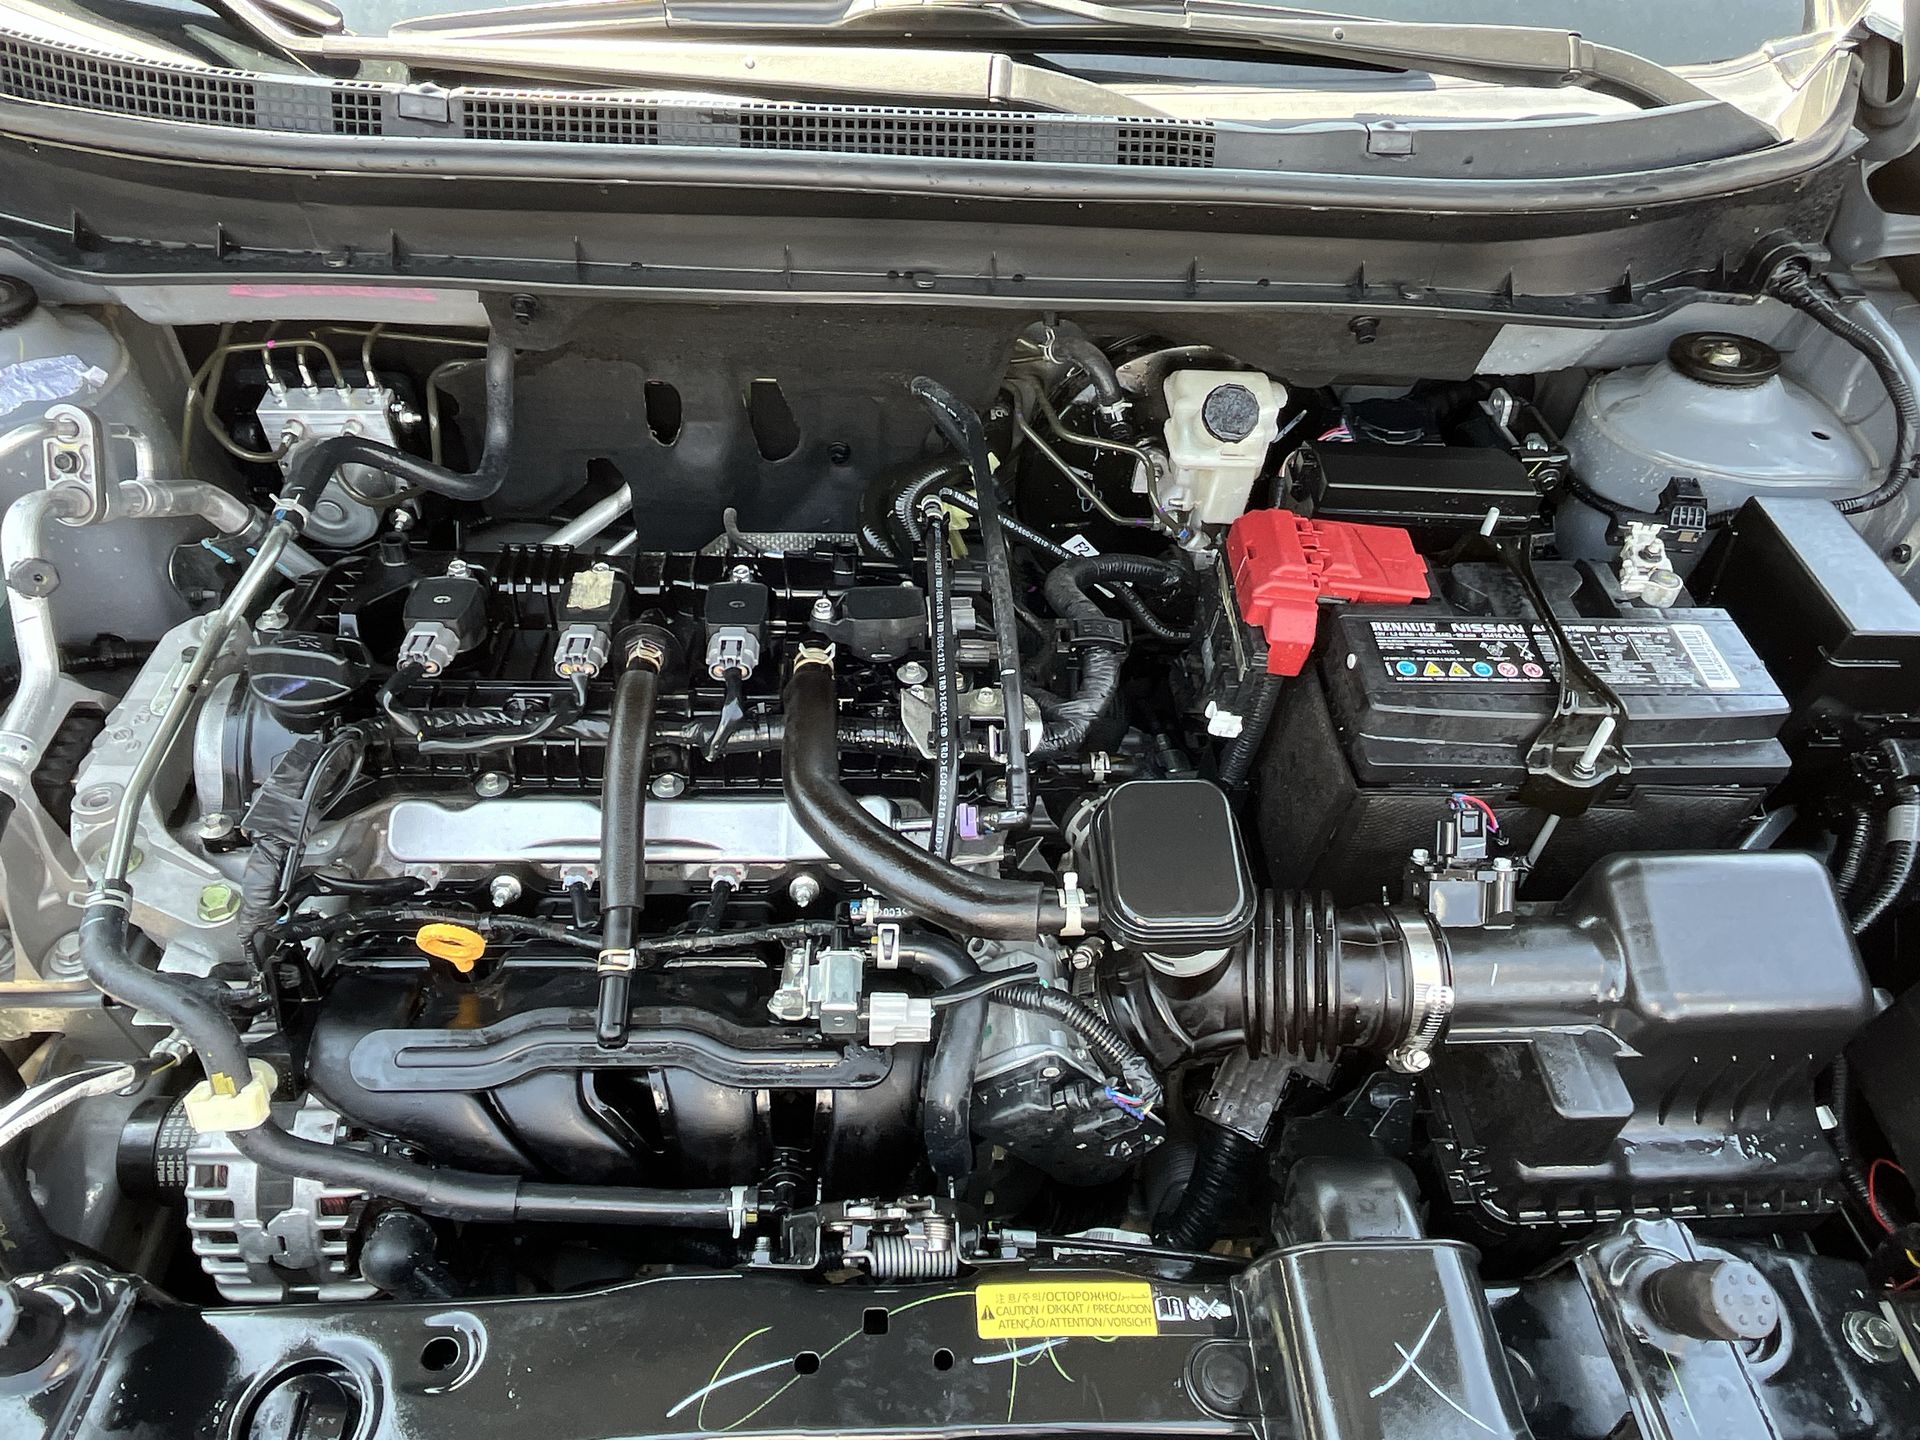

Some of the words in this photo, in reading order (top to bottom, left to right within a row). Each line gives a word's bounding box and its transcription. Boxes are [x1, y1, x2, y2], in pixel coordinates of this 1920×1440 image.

[1073, 541, 1090, 553] F2
[1370, 621, 1436, 632] RENAULT
[1450, 622, 1526, 633] NISSAN
[996, 1305, 1039, 1316] CAUTION
